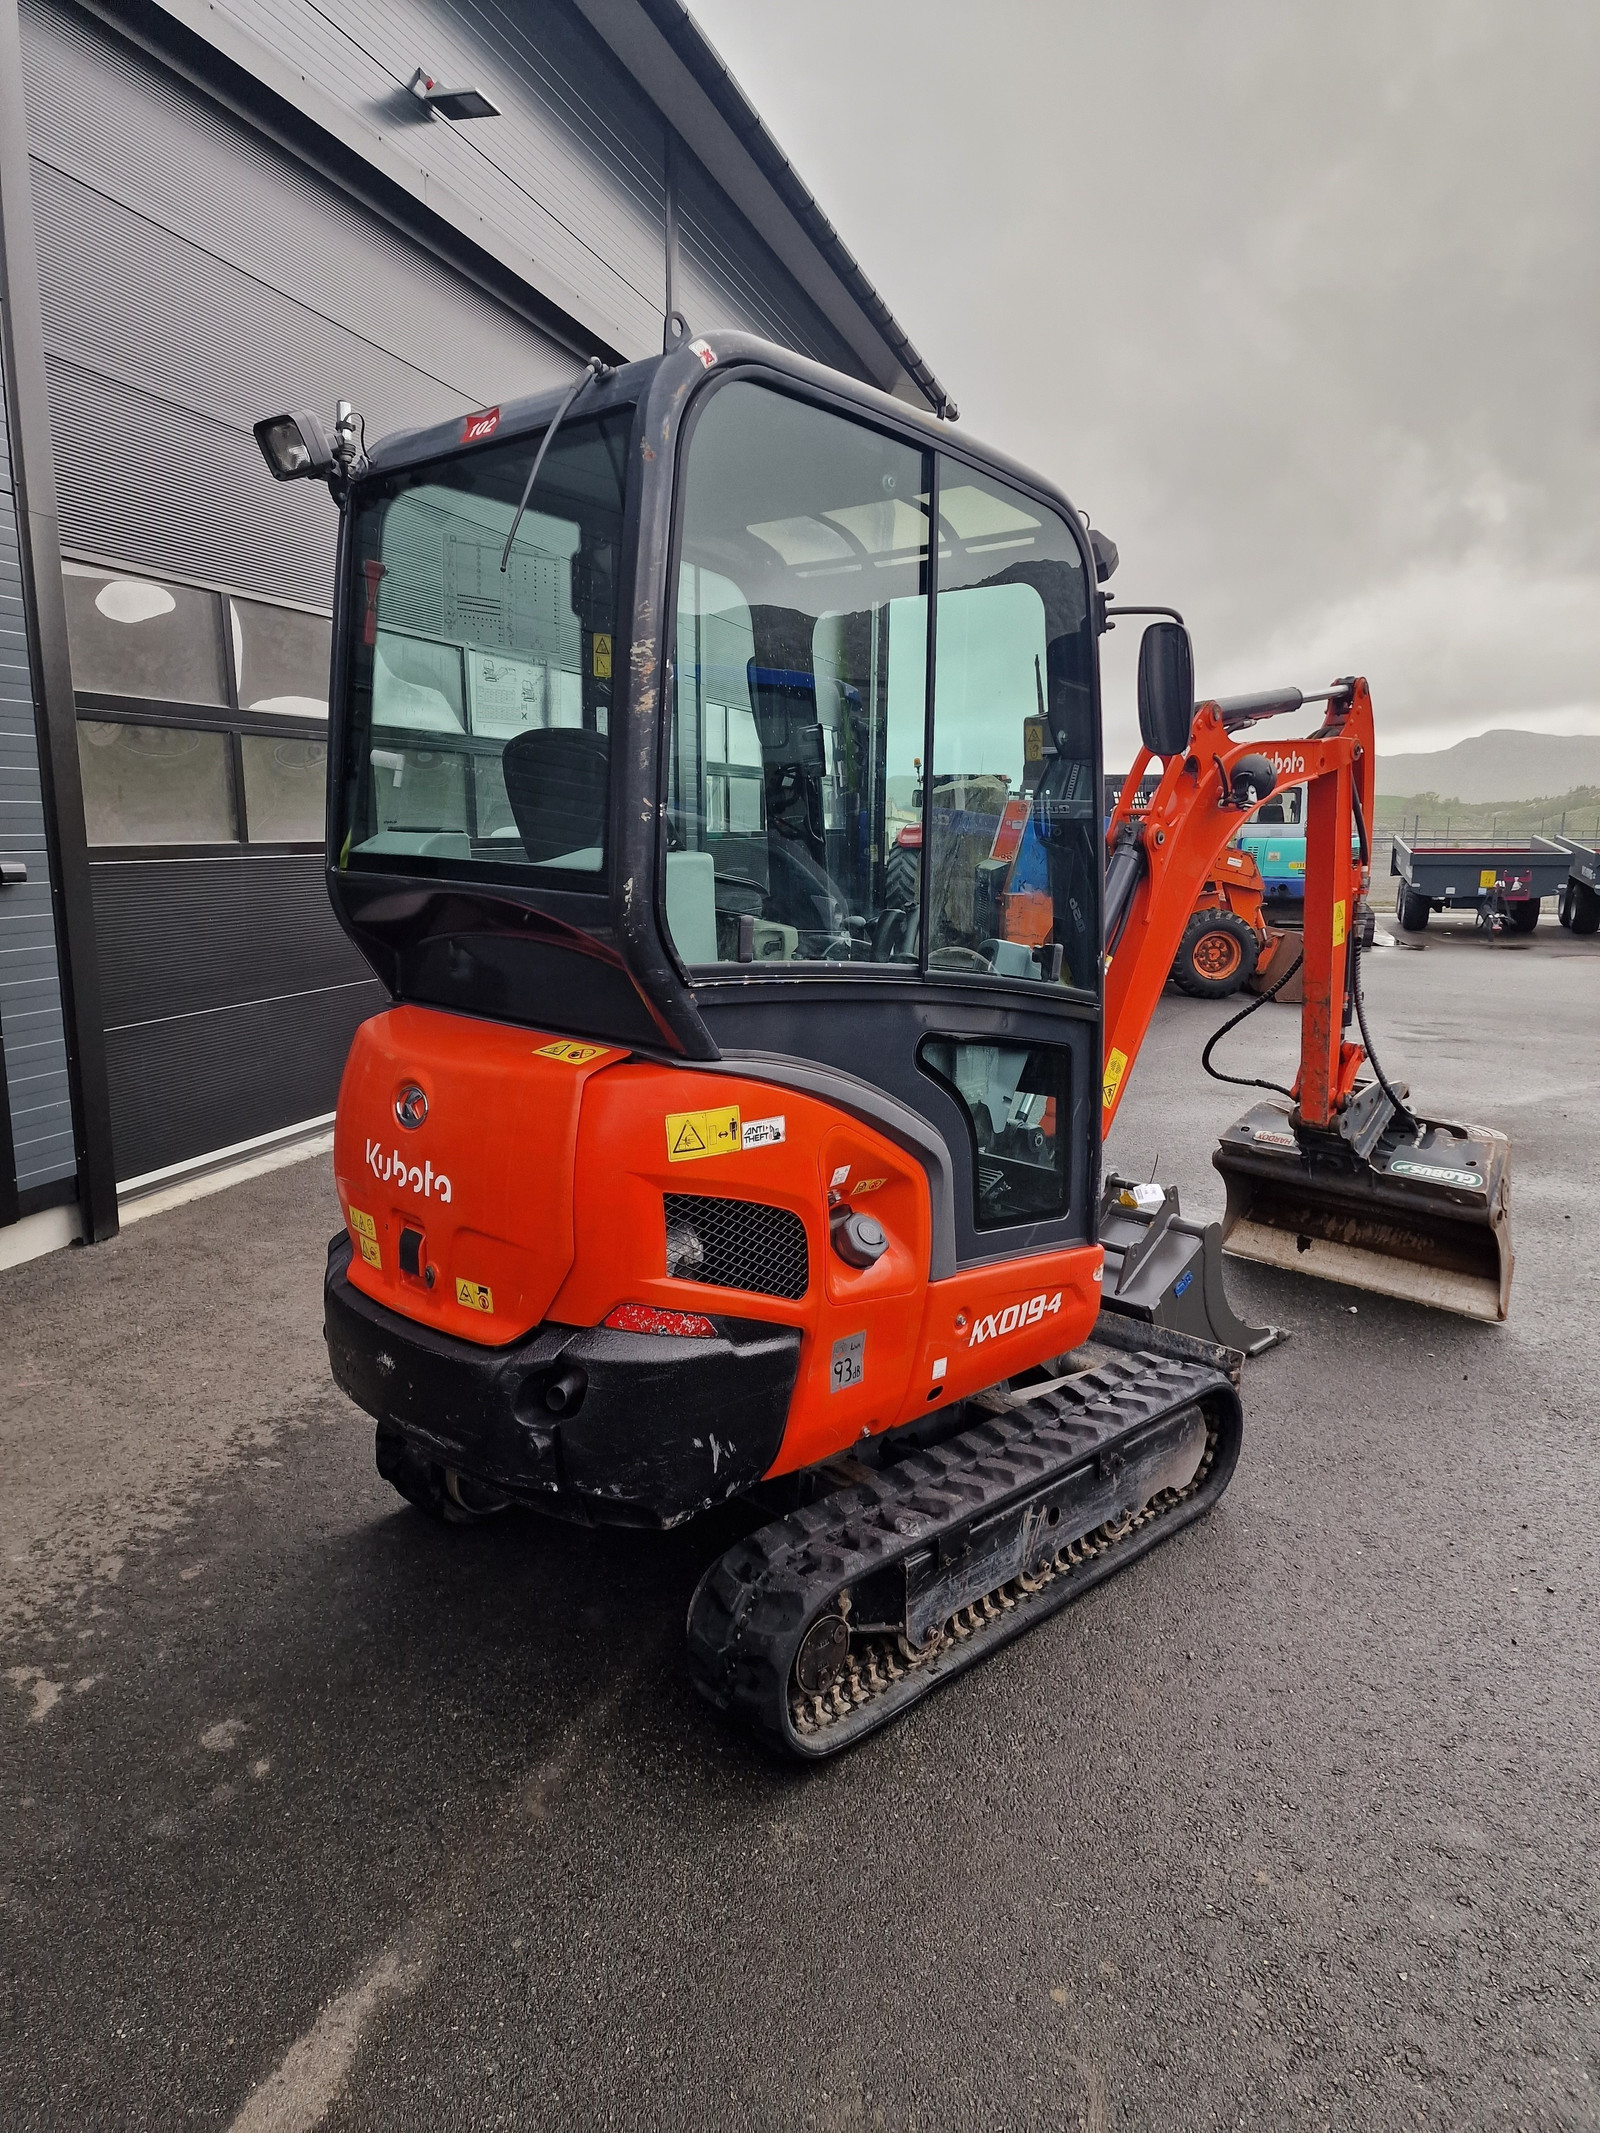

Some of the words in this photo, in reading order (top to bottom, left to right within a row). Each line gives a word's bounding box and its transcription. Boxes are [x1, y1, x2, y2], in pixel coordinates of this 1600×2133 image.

[468, 416, 497, 438] 102
[1256, 750, 1305, 775] bota
[743, 1132, 770, 1144] THEFT
[744, 1124, 766, 1136] ANTI
[1257, 1132, 1293, 1145] HARDOX
[365, 1138, 452, 1204] Kubota
[1410, 1164, 1477, 1185] GLOBUS
[967, 1291, 1063, 1348] KX019-4
